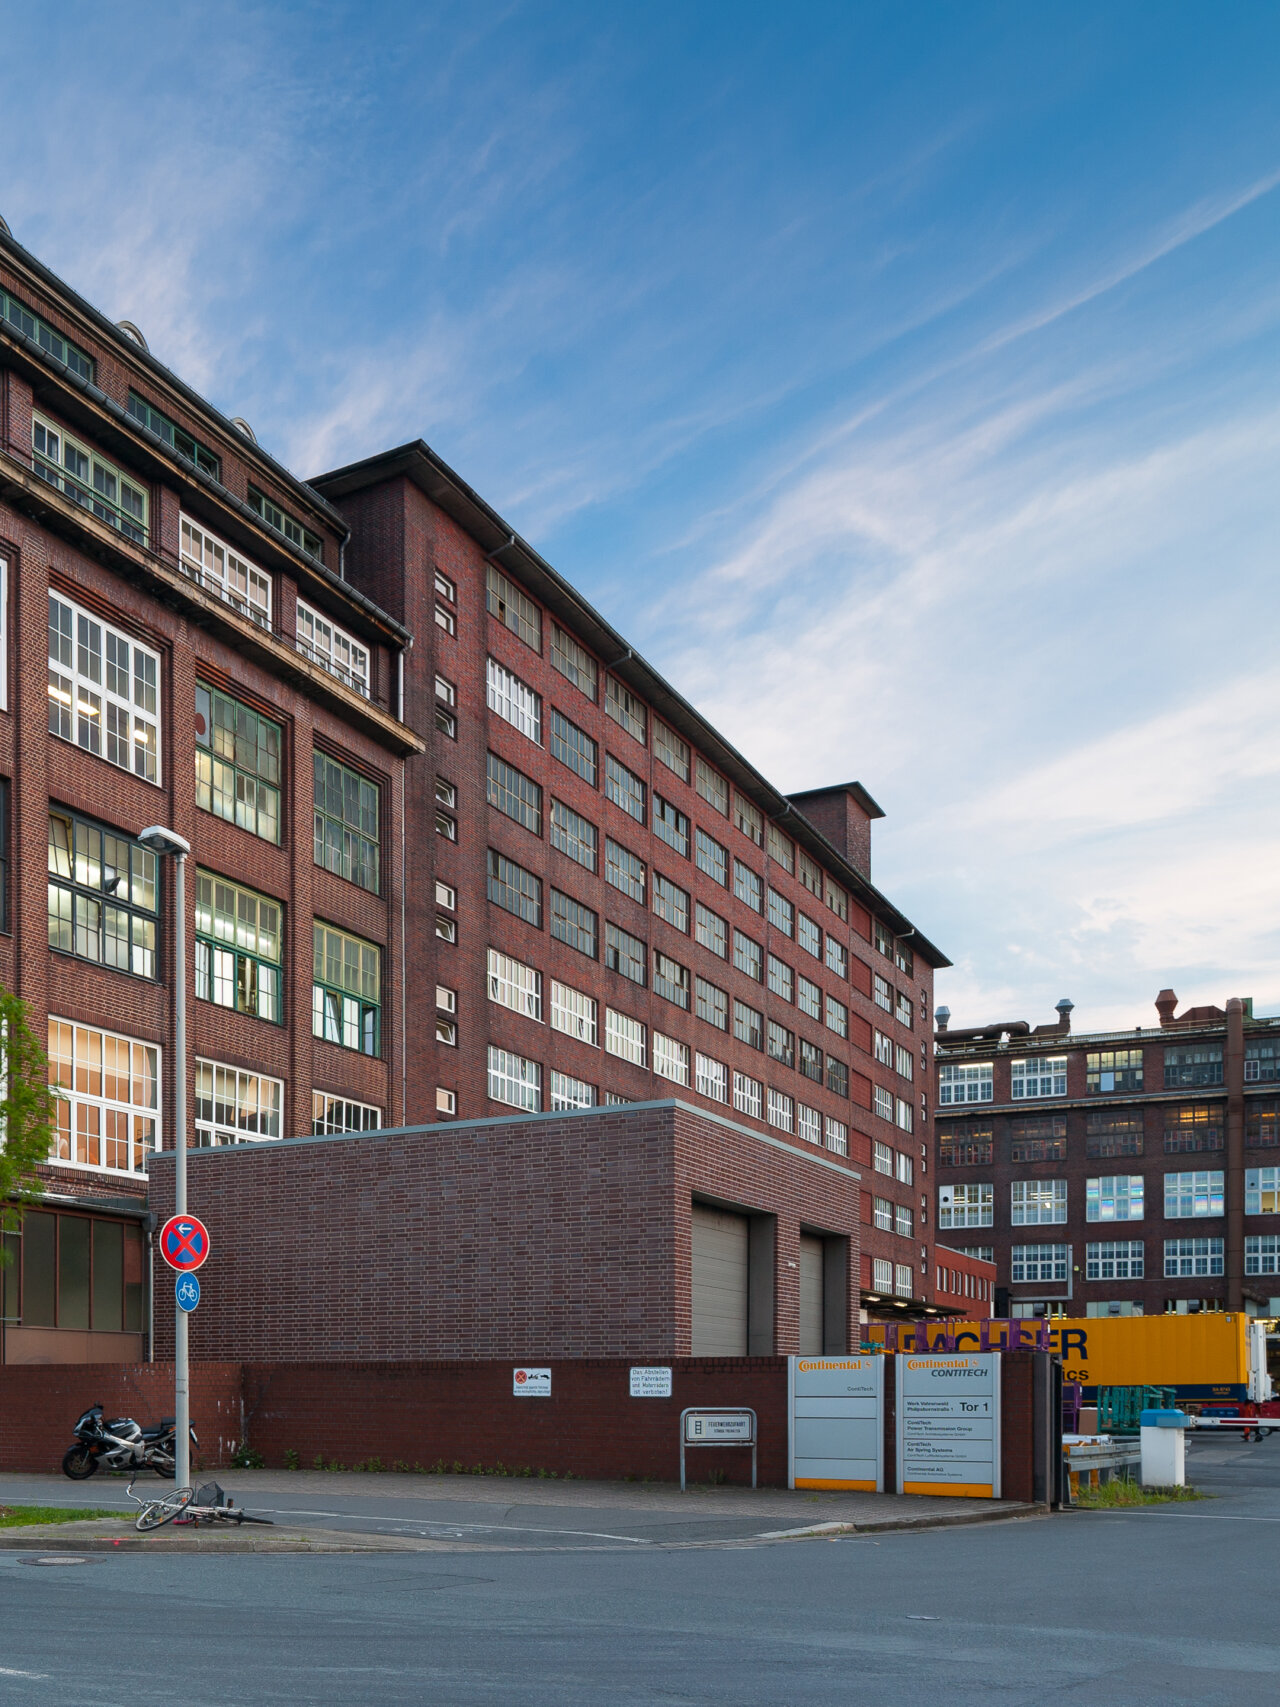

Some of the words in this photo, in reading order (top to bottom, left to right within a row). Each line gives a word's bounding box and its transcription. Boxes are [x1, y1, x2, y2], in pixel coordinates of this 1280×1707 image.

[798, 1360, 862, 1372] Continental
[907, 1359, 969, 1370] Continental
[931, 1369, 988, 1377] CONTITECH
[960, 1401, 979, 1412] Tor
[982, 1401, 989, 1412] 1
